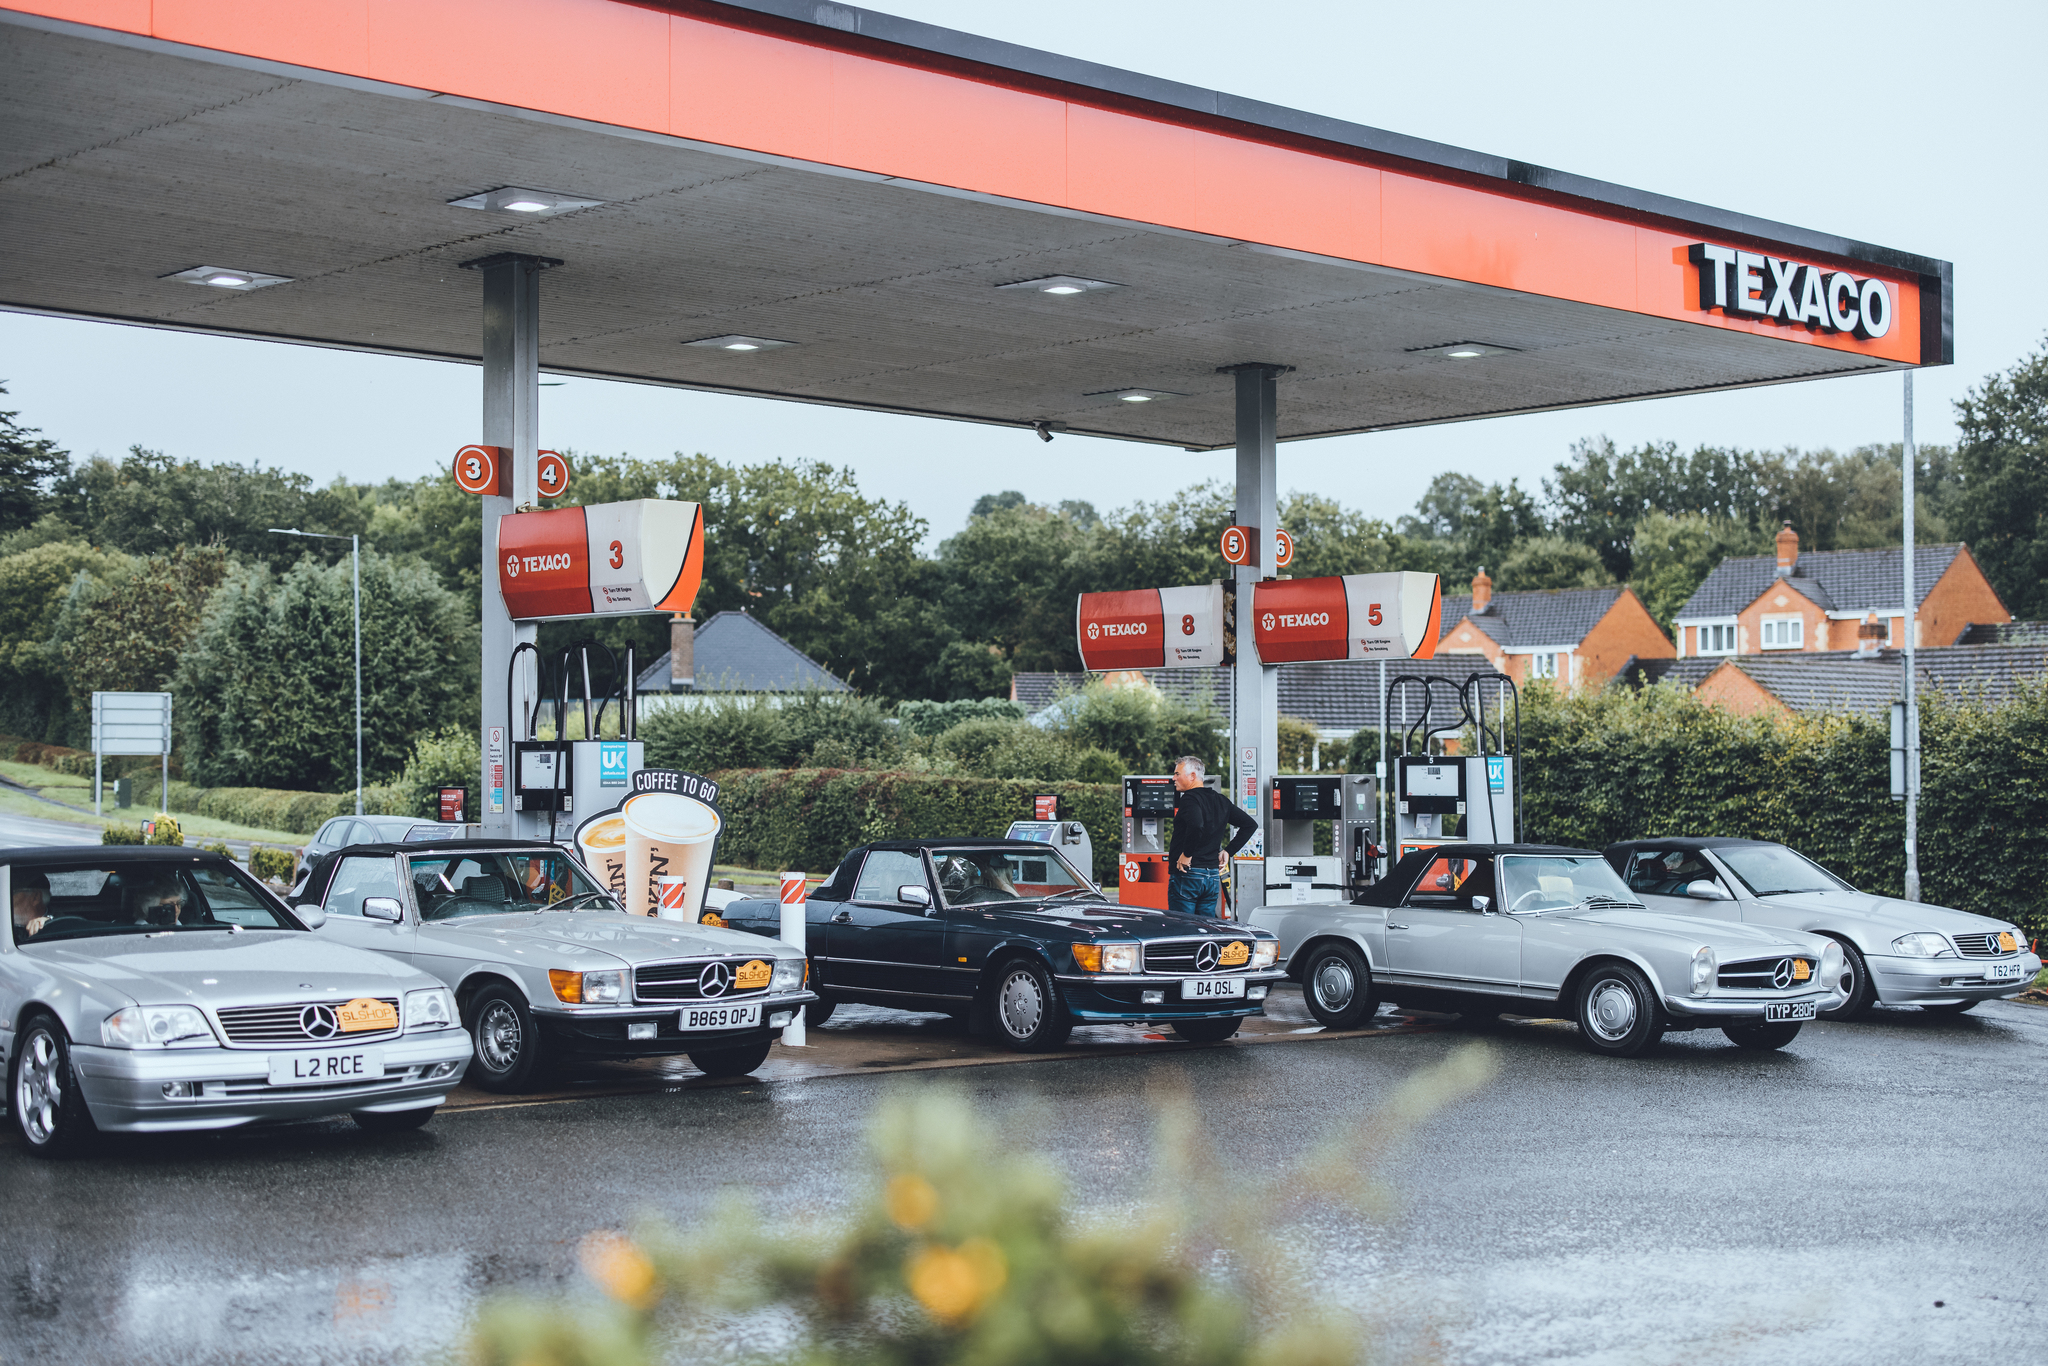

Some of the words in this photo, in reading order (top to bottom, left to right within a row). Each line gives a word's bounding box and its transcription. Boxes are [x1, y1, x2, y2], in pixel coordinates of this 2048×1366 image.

[1698, 243, 1892, 338] TEXACO
[466, 458, 482, 480] 3
[542, 464, 557, 486] 4
[1228, 536, 1239, 554] 5
[1276, 539, 1286, 557] 6
[522, 553, 571, 572] TEXACO
[609, 540, 624, 570] 3
[1278, 612, 1329, 627] TEXACO
[1368, 603, 1382, 626] 5
[1102, 622, 1147, 636] TEXACO
[1182, 614, 1195, 636] 8
[603, 751, 625, 769] UK
[1489, 765, 1503, 780] UK
[636, 772, 678, 791] COFFEE
[683, 775, 698, 794] TO
[699, 782, 716, 802] GO
[1993, 965, 2008, 977] T62
[2009, 964, 2020, 976] HFR
[1197, 982, 1211, 995] D4
[1215, 981, 1234, 995] OSL
[689, 1010, 727, 1026] B869
[731, 1007, 756, 1024] OPJ
[1769, 1004, 1790, 1018] TYP
[1792, 1003, 1814, 1018] 280F
[295, 1058, 320, 1078] L2
[328, 1055, 364, 1076] RCE
